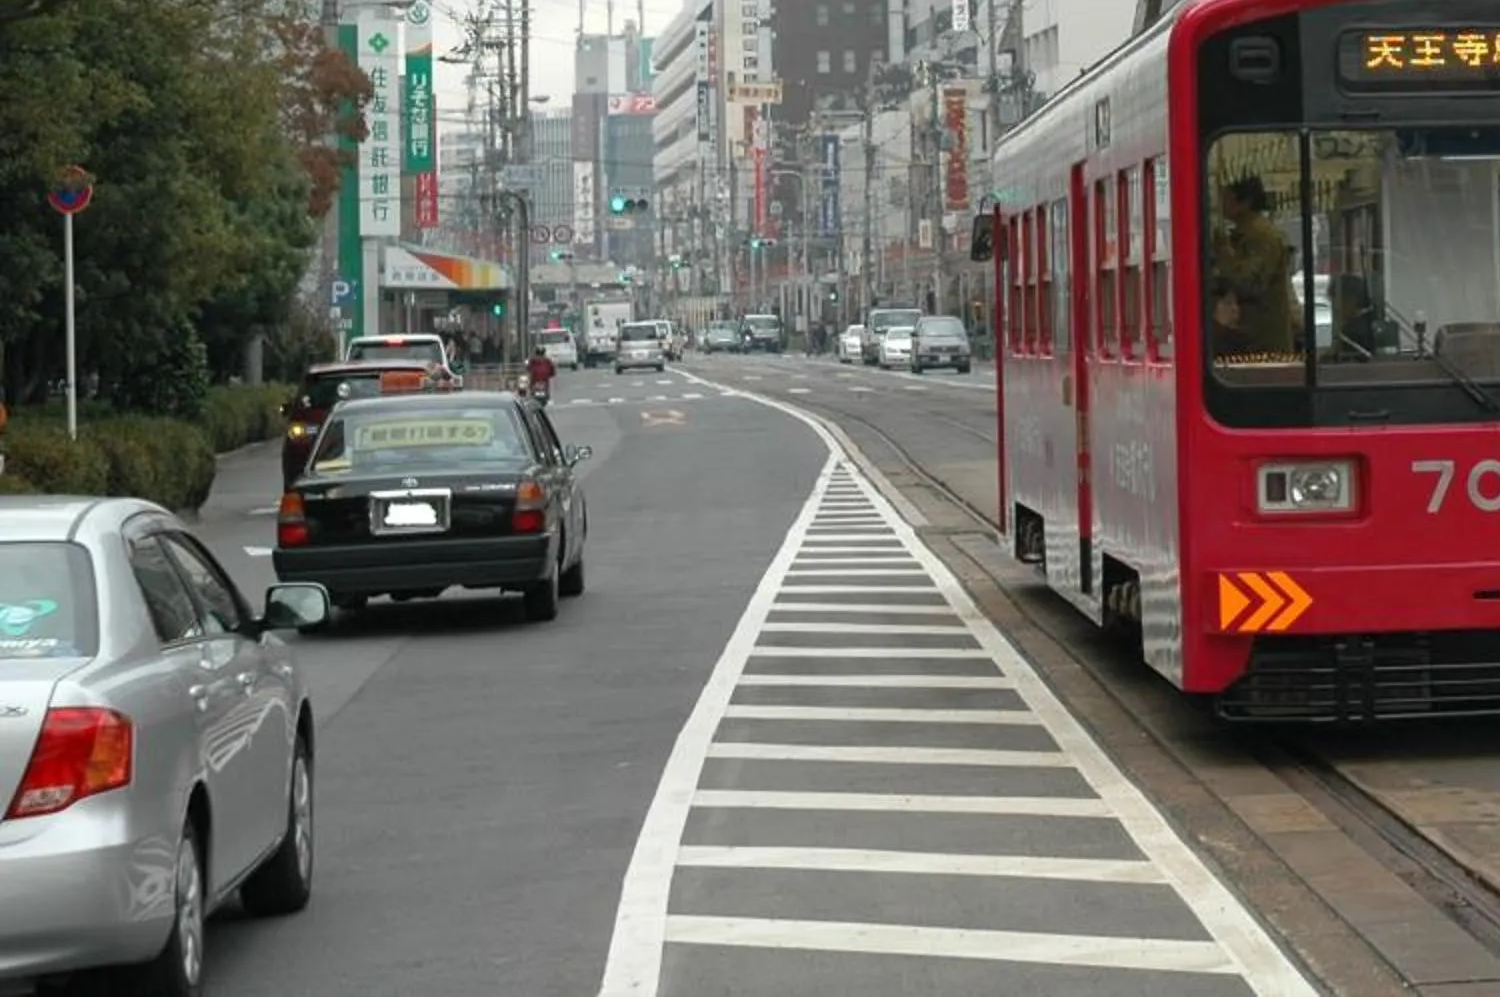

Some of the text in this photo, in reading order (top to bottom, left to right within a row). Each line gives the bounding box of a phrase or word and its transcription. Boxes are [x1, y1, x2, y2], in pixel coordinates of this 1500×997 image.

[371, 66, 388, 221] 住友信託銀行
[411, 72, 429, 157] りそな銀行
[332, 280, 349, 303] P
